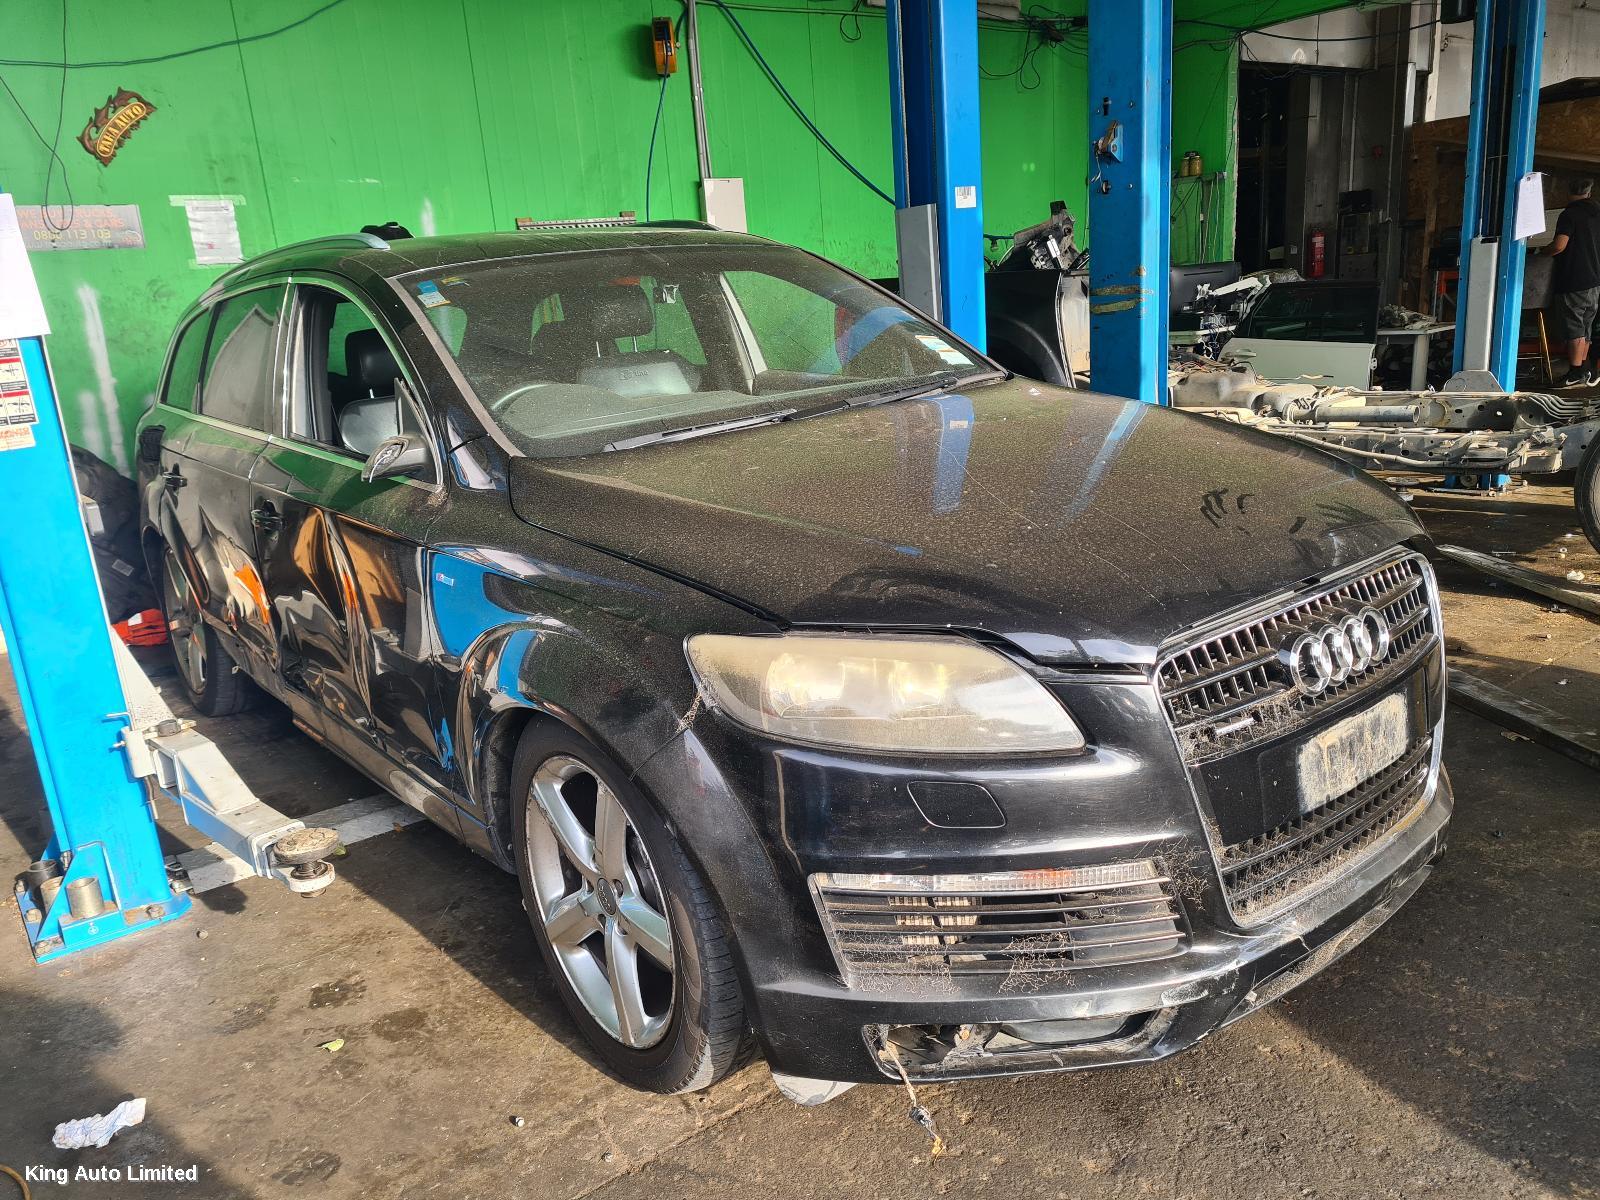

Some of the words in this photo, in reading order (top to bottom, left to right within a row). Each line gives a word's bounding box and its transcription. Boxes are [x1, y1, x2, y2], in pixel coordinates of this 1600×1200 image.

[98, 126, 120, 153] TAHA
[115, 105, 142, 128] AUTO
[33, 230, 62, 240] 0800
[66, 230, 86, 240] 113
[92, 229, 111, 239] 103
